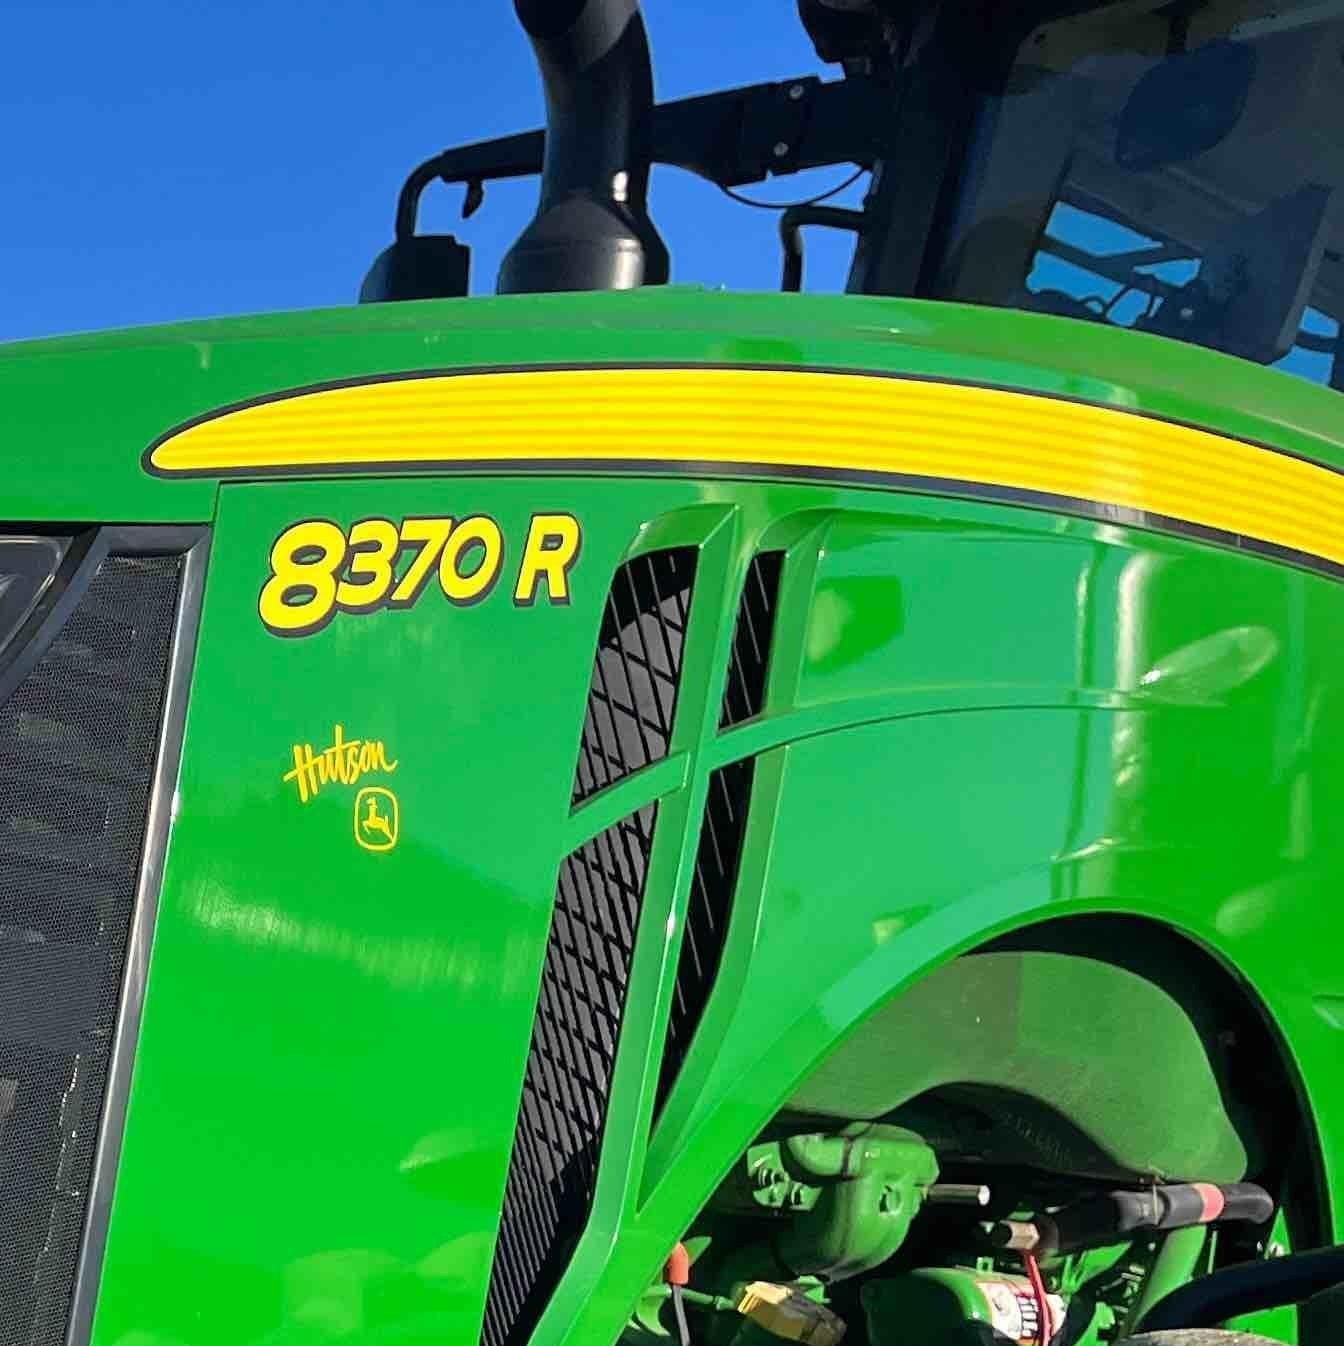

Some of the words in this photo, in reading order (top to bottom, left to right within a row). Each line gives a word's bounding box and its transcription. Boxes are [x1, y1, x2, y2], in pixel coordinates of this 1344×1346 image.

[258, 514, 505, 638] 8370
[512, 511, 581, 607] R
[282, 724, 399, 803] Hutson
